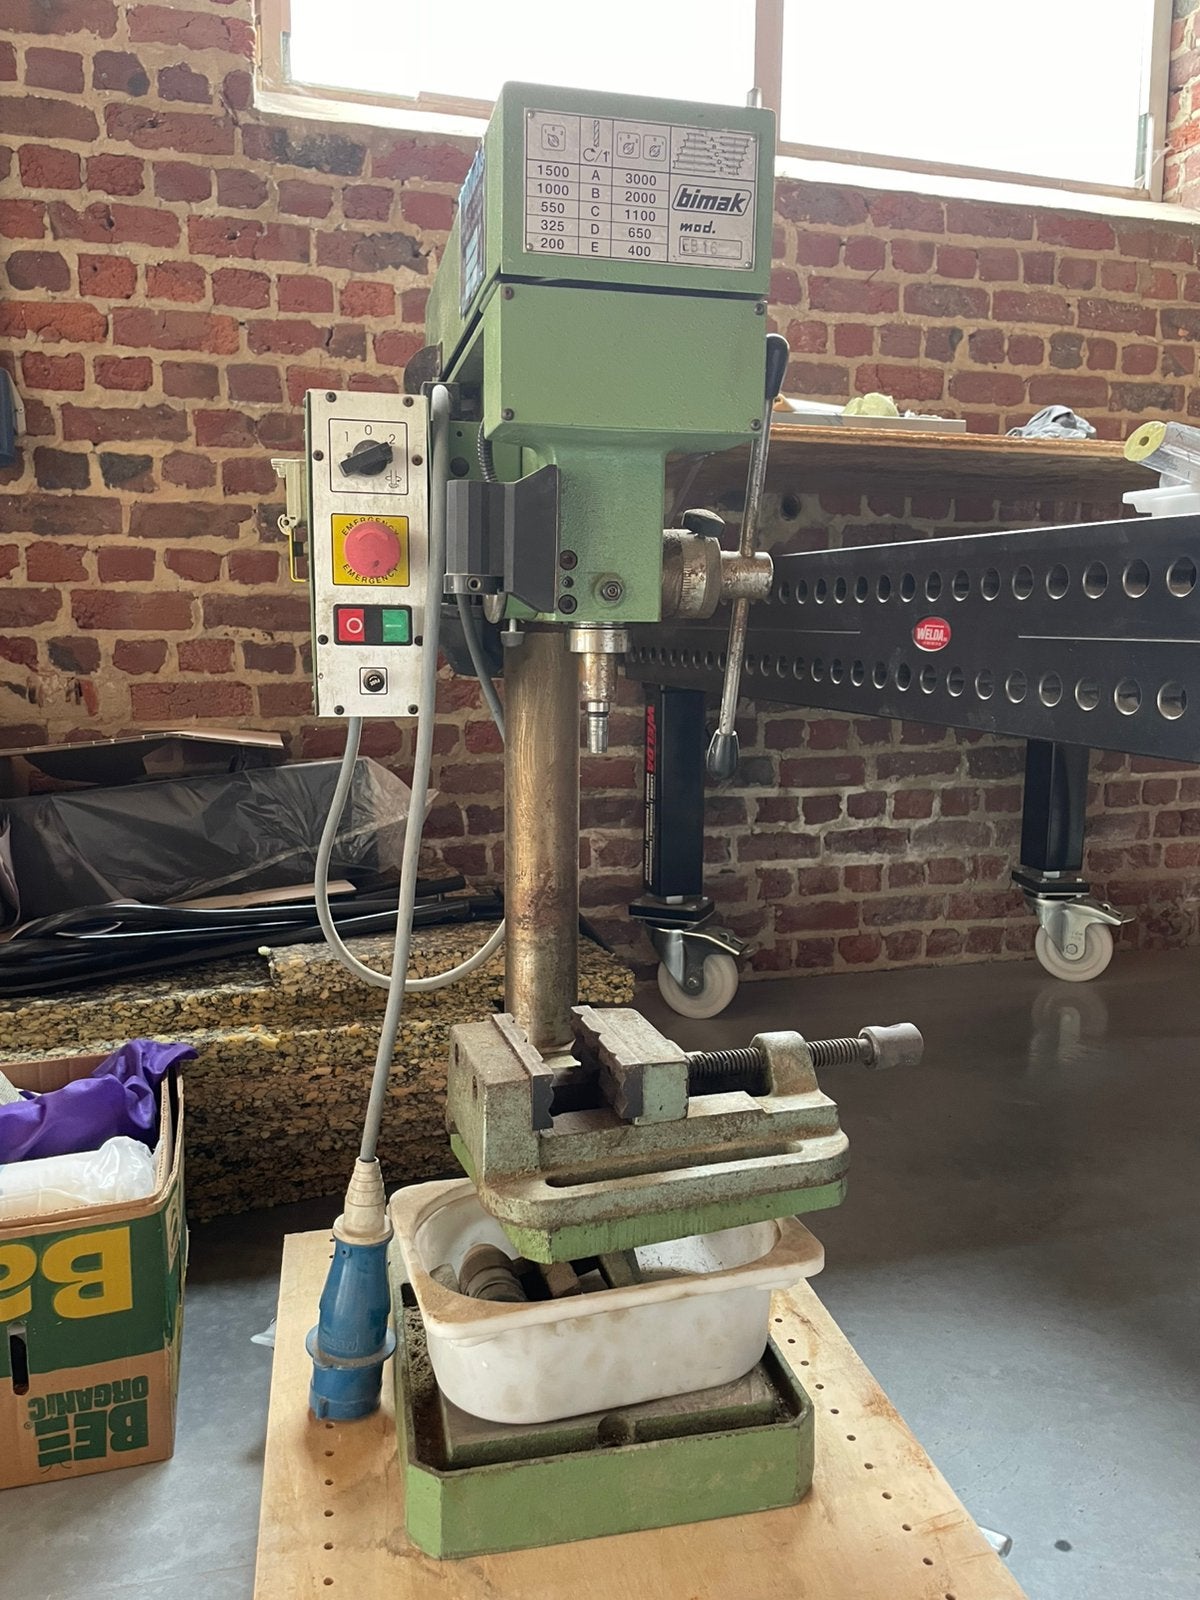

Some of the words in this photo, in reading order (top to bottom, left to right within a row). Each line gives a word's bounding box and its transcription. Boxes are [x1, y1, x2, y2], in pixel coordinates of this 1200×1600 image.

[537, 165, 569, 177] 1500
[591, 170, 600, 181] A
[625, 173, 657, 186] 3000
[537, 183, 569, 196] 1000
[591, 187, 600, 199] B
[625, 191, 656, 204] 2000
[676, 187, 746, 213] bimak
[541, 201, 565, 214] 550
[590, 205, 600, 217] C
[625, 209, 656, 222] 1100
[541, 219, 565, 232] 325
[591, 223, 600, 235] D
[628, 227, 652, 240] 650
[680, 220, 716, 234] mod.
[540, 237, 564, 250] 200
[591, 241, 599, 253] E
[628, 245, 651, 257] 400
[345, 431, 349, 442] 1
[364, 424, 373, 436] 0
[389, 433, 396, 445] 2
[342, 563, 399, 585] EMERGENCY
[646, 705, 657, 774] WELDA
